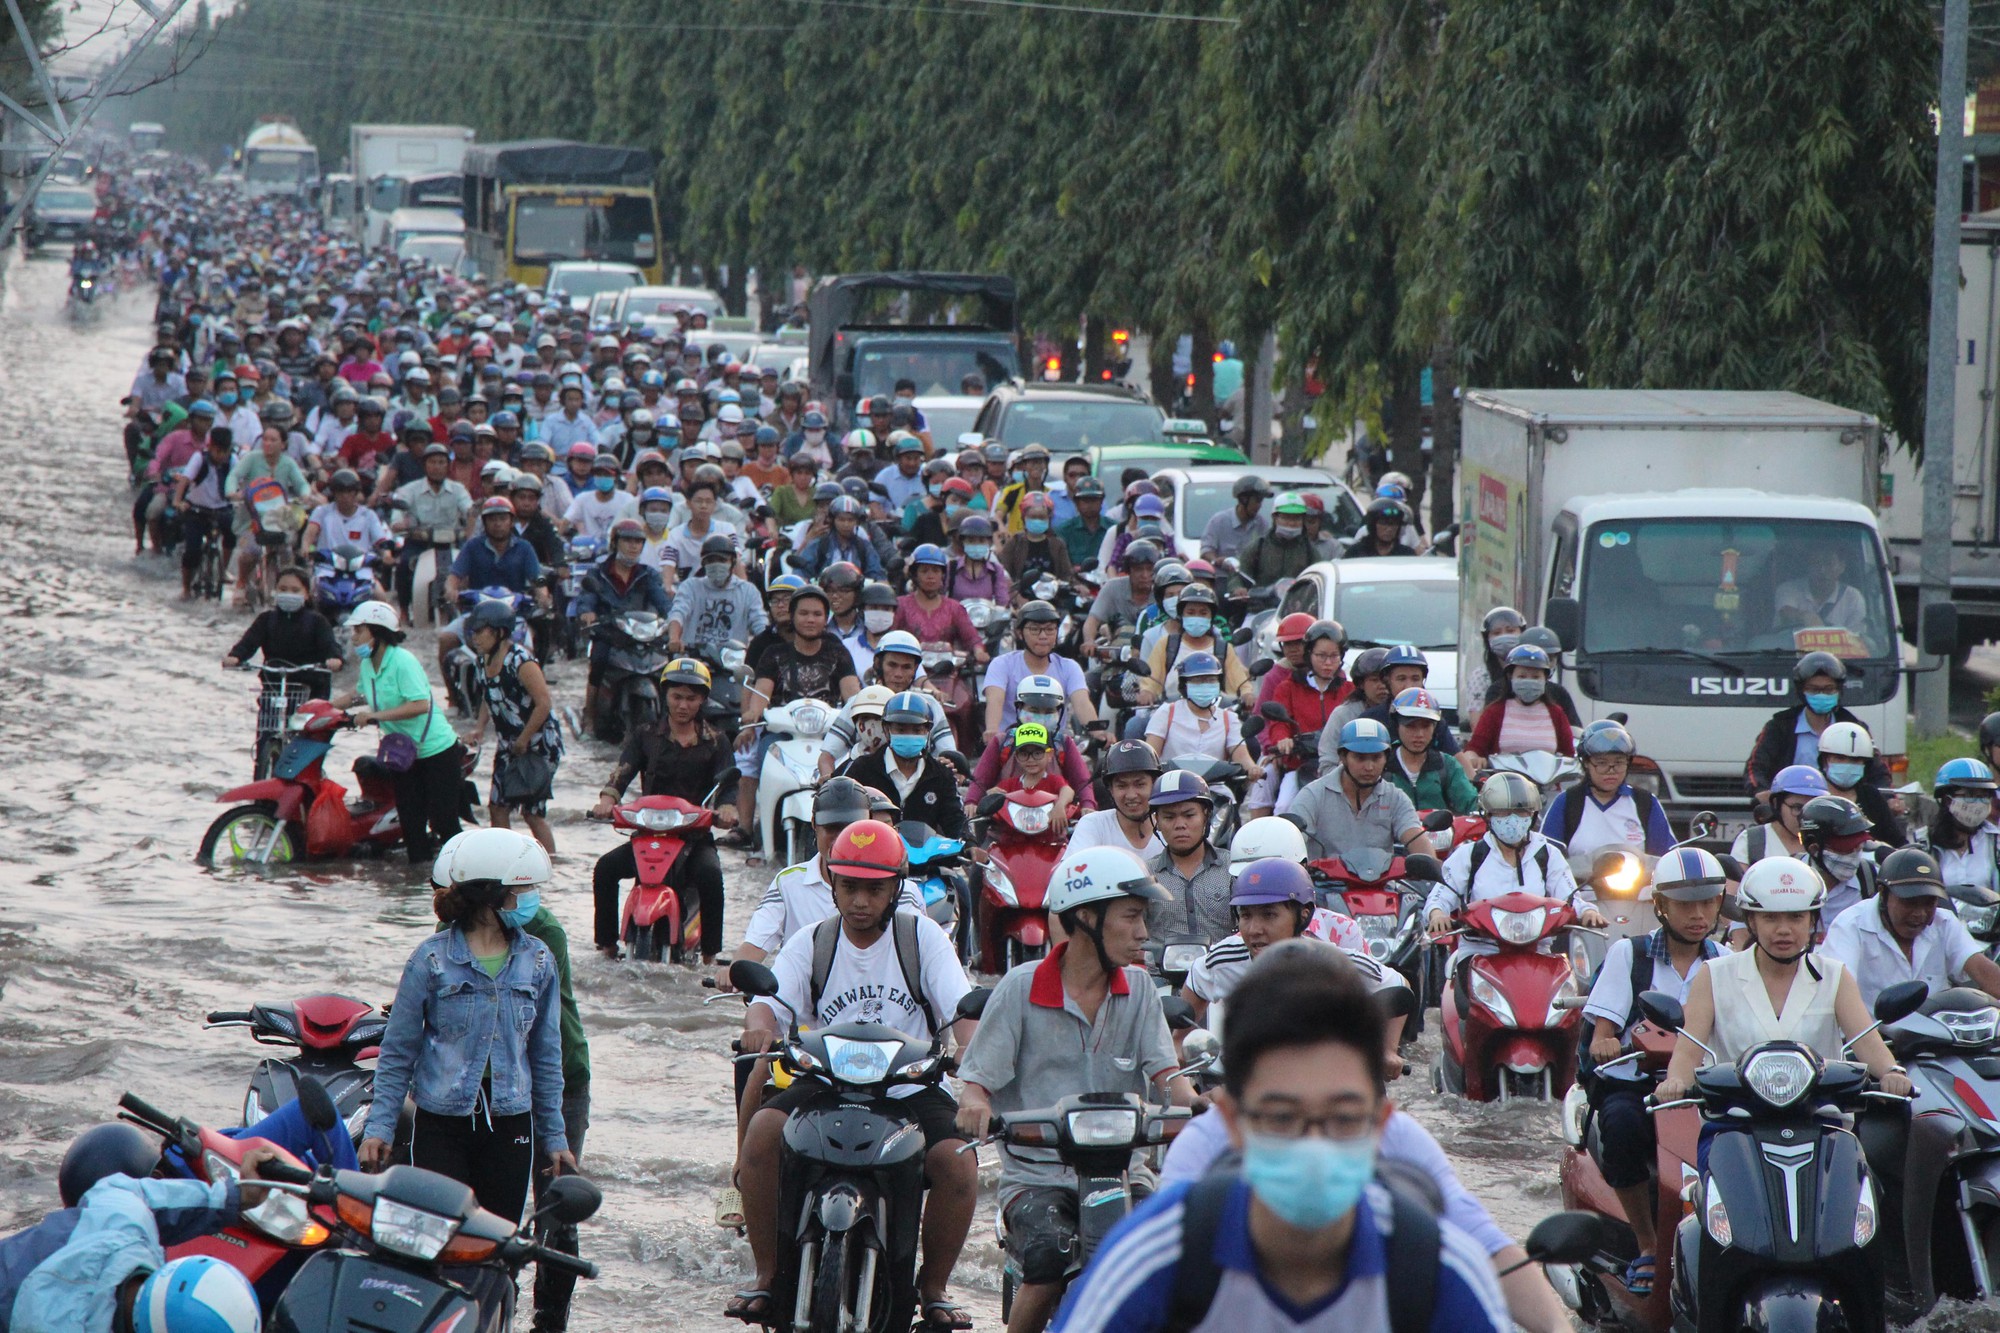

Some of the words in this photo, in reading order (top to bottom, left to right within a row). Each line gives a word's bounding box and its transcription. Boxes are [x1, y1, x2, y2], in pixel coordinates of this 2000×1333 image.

[1691, 677, 1789, 695] ISUZU
[1064, 875, 1093, 892] TOA
[888, 987, 917, 1017] EAST
[838, 1103, 871, 1111] HONDA
